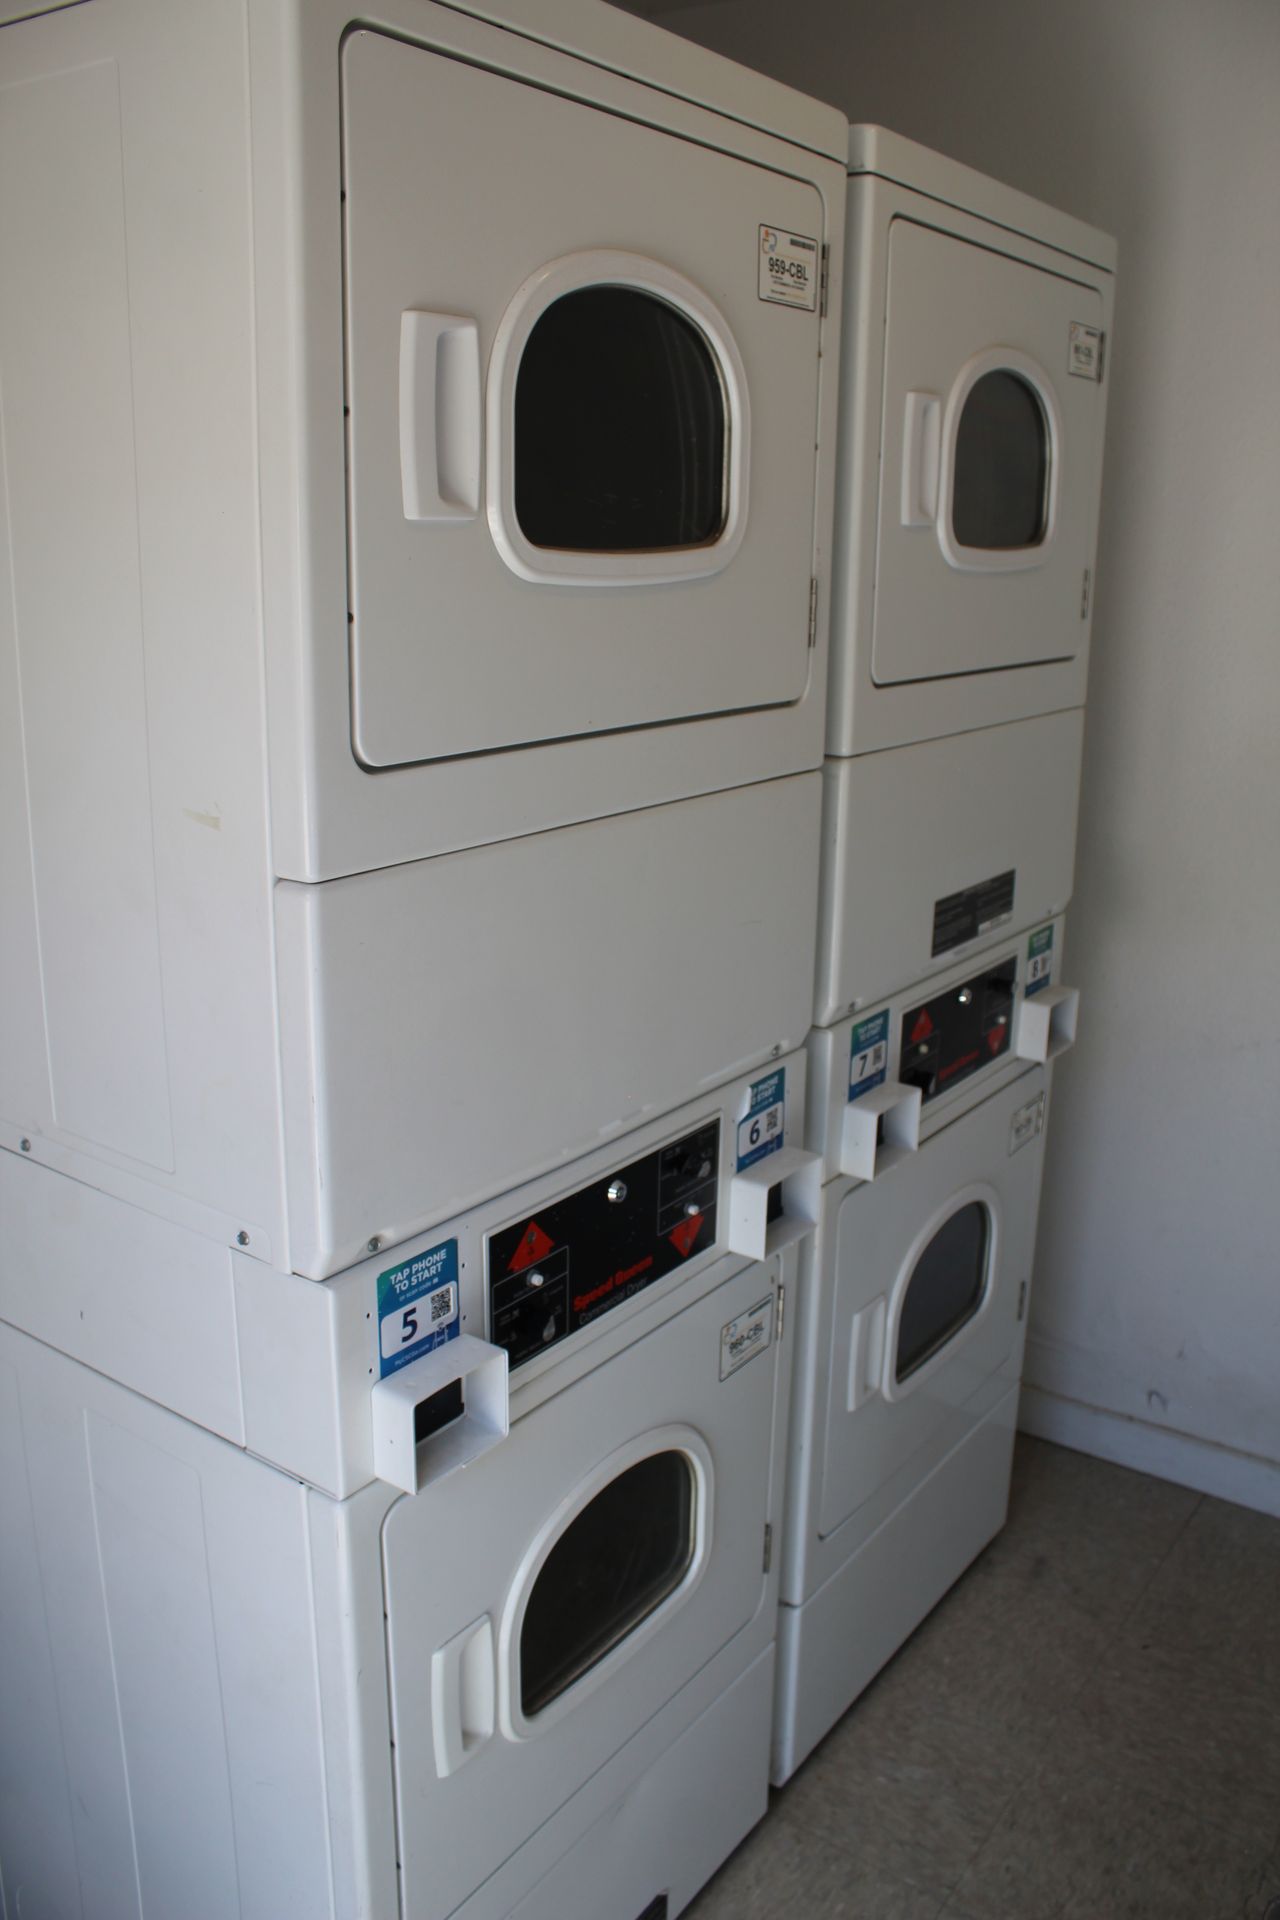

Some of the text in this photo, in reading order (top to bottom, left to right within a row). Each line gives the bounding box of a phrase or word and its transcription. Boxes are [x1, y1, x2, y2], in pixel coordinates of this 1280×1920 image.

[768, 257, 809, 281] 959-CBL
[859, 1053, 868, 1077] 7
[749, 1119, 760, 1145] 6
[389, 1249, 447, 1285] TAP PHONE
[395, 1262, 443, 1294] TO START
[573, 1276, 613, 1312] Speed
[626, 1276, 649, 1296] Dryer
[401, 1306, 418, 1343] 5
